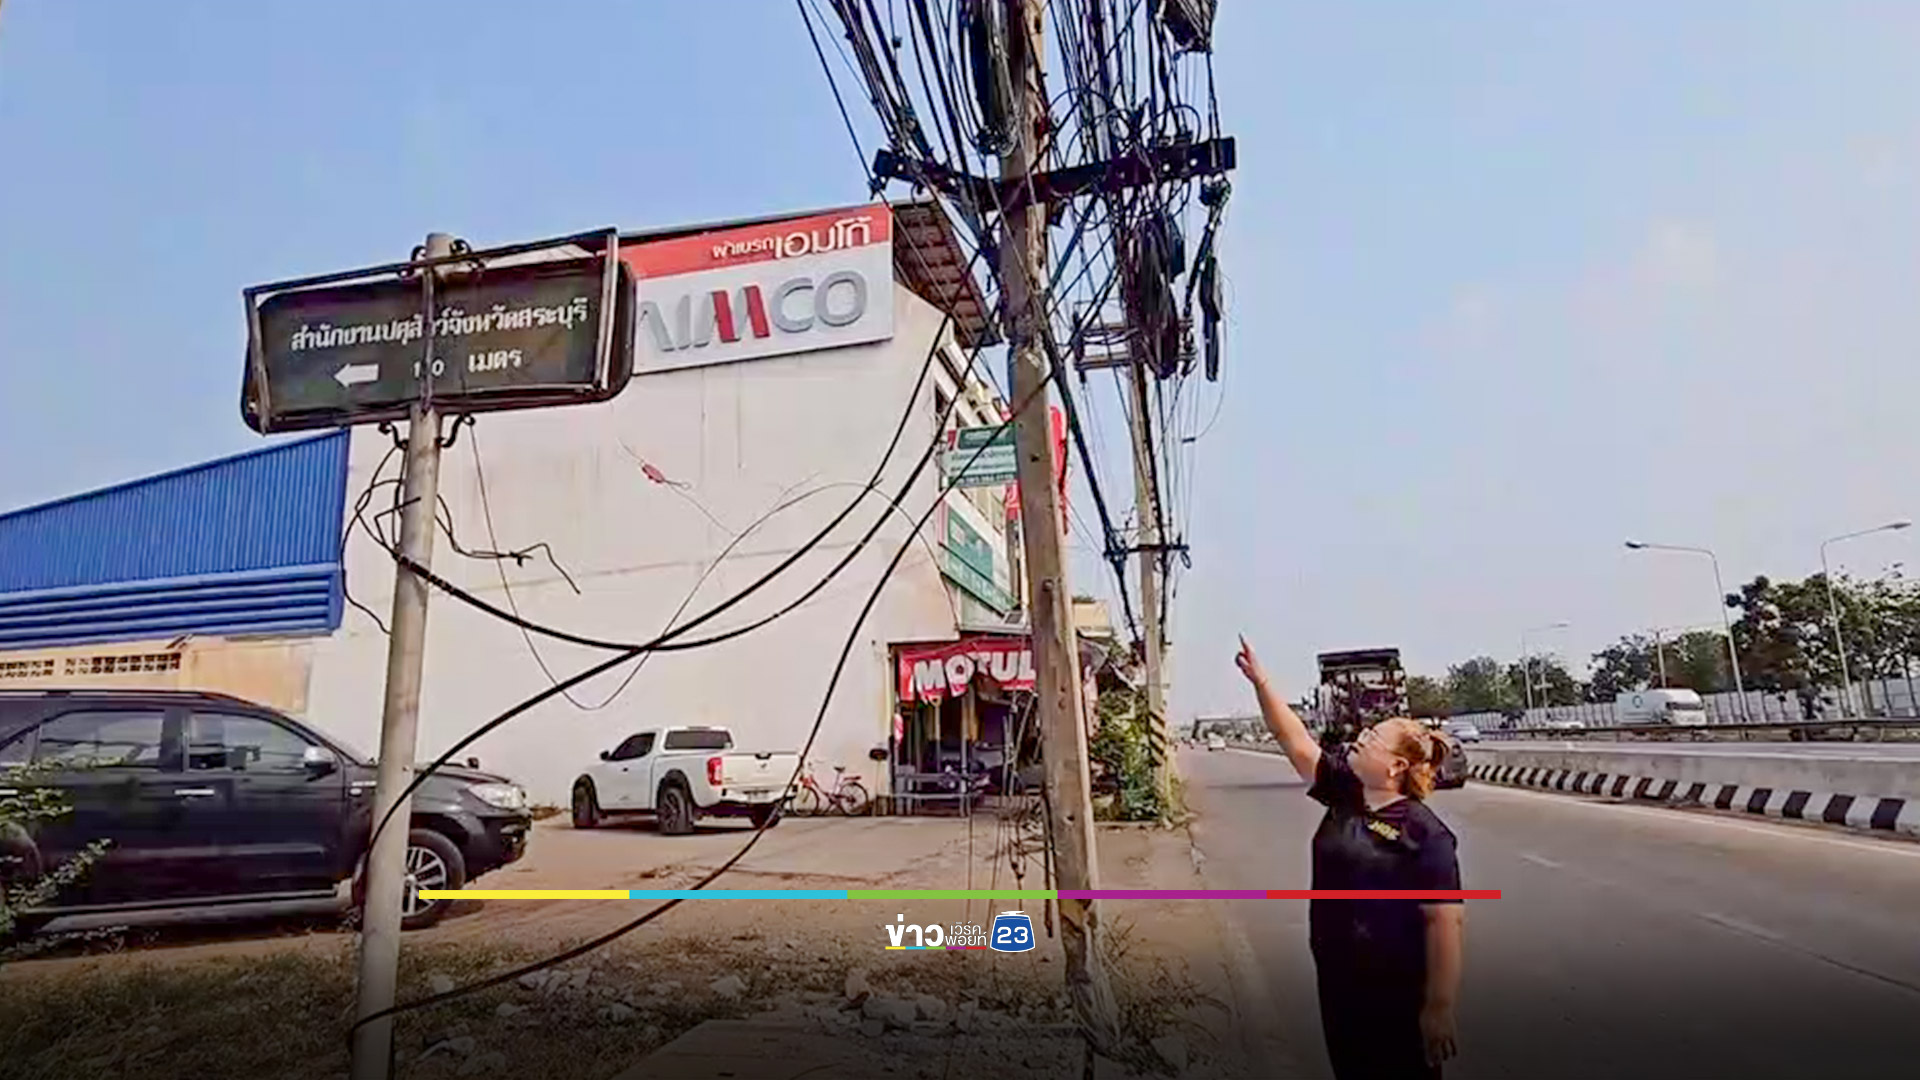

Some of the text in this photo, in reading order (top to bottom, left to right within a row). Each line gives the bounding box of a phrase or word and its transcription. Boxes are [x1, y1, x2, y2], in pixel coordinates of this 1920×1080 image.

[775, 216, 872, 259] เอมโก้
[413, 359, 445, 378] 10
[468, 349, 1036, 690] เมตร MOTUL
